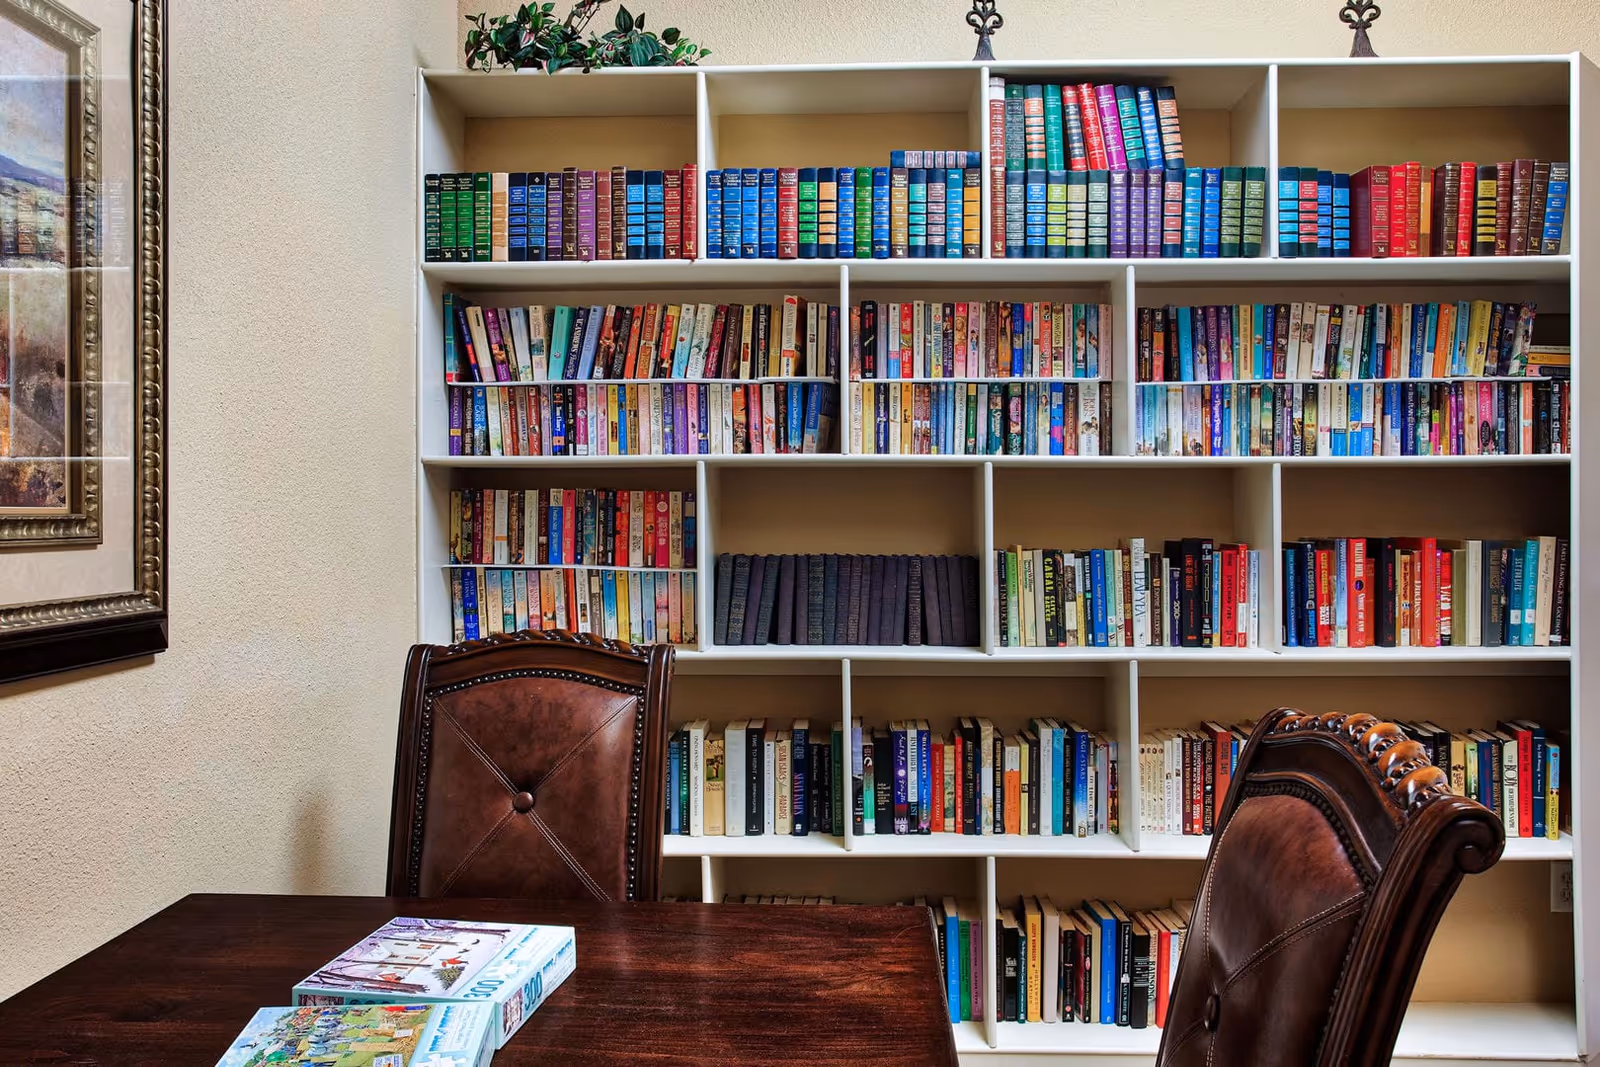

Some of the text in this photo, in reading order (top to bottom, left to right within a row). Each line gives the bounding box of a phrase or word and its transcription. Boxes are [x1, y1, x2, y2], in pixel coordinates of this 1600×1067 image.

[1307, 551, 1315, 570] CLIVE
[1044, 557, 1055, 593] CABAL
[1133, 570, 1146, 595] LEAP
[1558, 563, 1567, 589] LEAVING
[1000, 584, 1008, 631] TIMBUKTU
[1308, 610, 1316, 639] SERPENT
[1205, 741, 1213, 785] MICHAEL PALMER
[1503, 764, 1518, 788] BODY
[1205, 805, 1214, 828] PATIENT
[463, 979, 504, 998] 300
[524, 971, 543, 1011] 300
[1148, 960, 1157, 1001] RAINSONG
